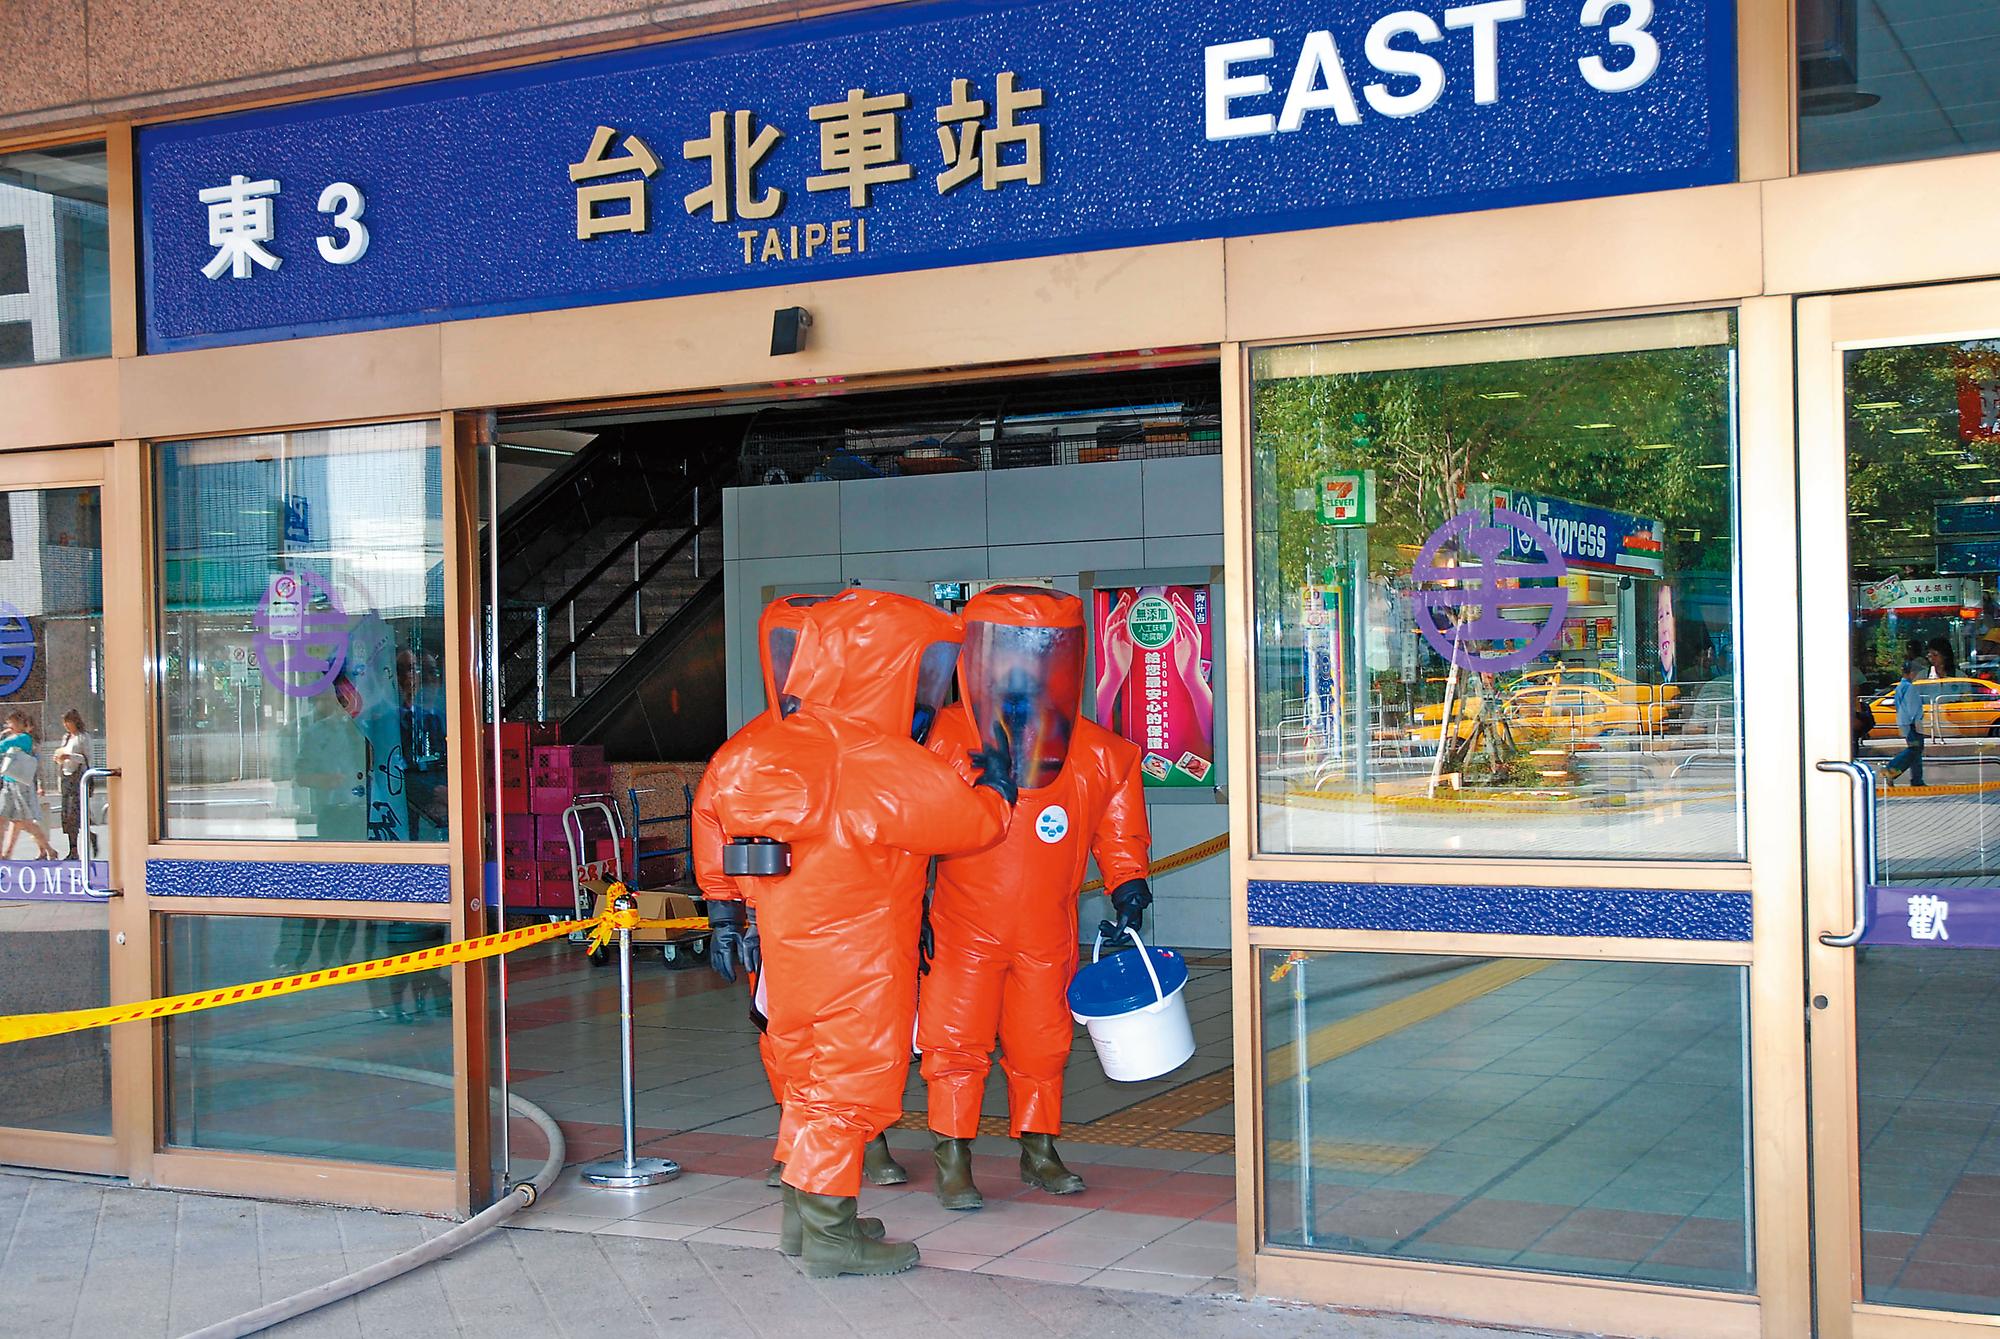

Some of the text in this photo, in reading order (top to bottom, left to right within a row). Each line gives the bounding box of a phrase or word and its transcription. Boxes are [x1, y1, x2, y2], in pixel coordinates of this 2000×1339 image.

[1204, 0, 1661, 141] EAST 3
[568, 72, 1044, 241] 台北車站
[199, 175, 370, 280] 東 3
[738, 218, 866, 265] TAIPEI
[1537, 501, 1606, 559] Express
[1136, 608, 1168, 622] 無添加
[0, 866, 85, 895] COME
[1907, 894, 1949, 940] 歡
